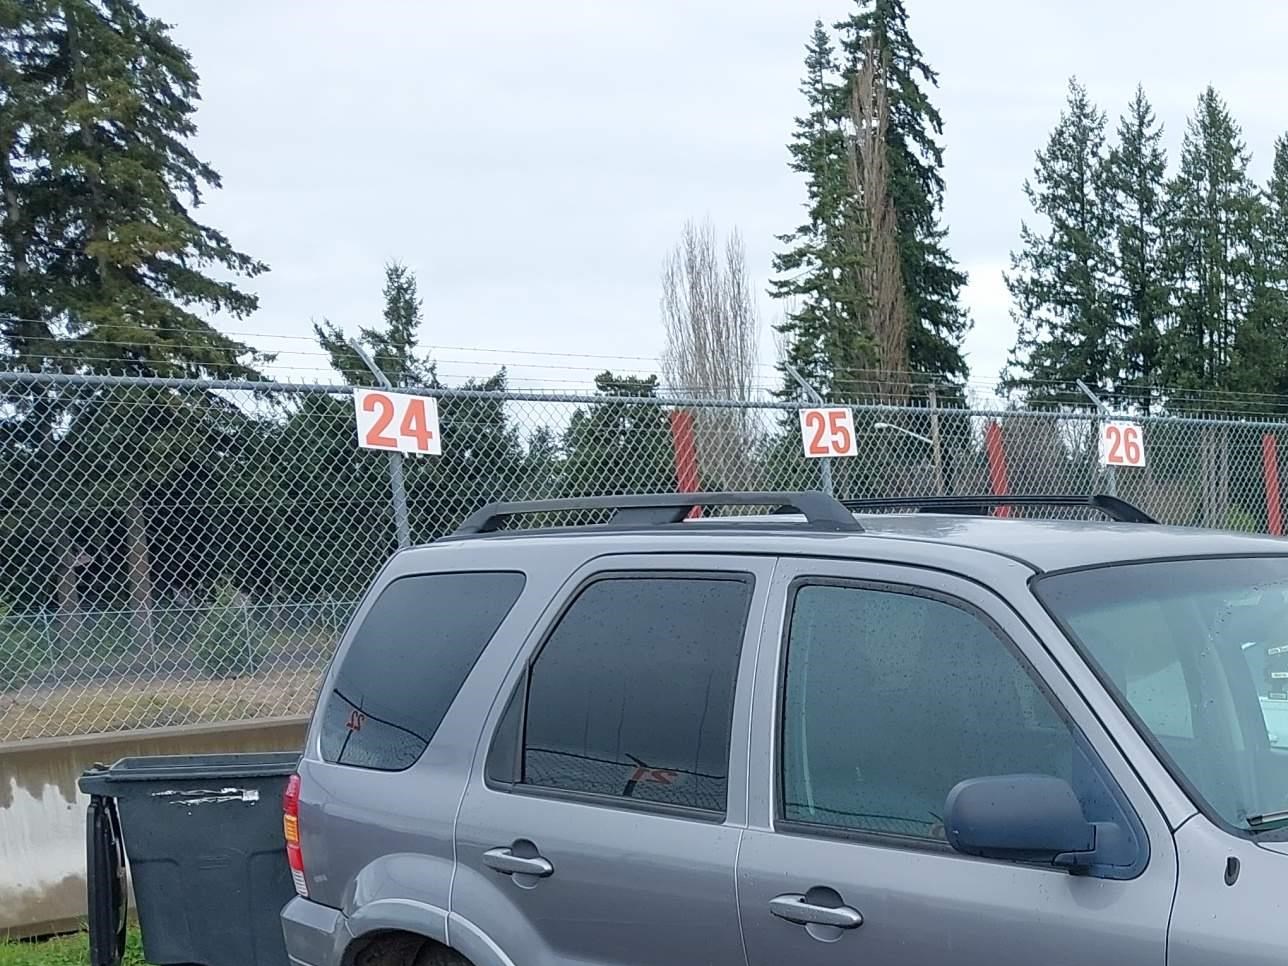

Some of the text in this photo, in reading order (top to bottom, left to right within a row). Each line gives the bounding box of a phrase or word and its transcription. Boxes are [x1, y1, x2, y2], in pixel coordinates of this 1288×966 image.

[363, 393, 433, 451] 24
[805, 411, 851, 454] 25
[1106, 426, 1140, 464] 26
